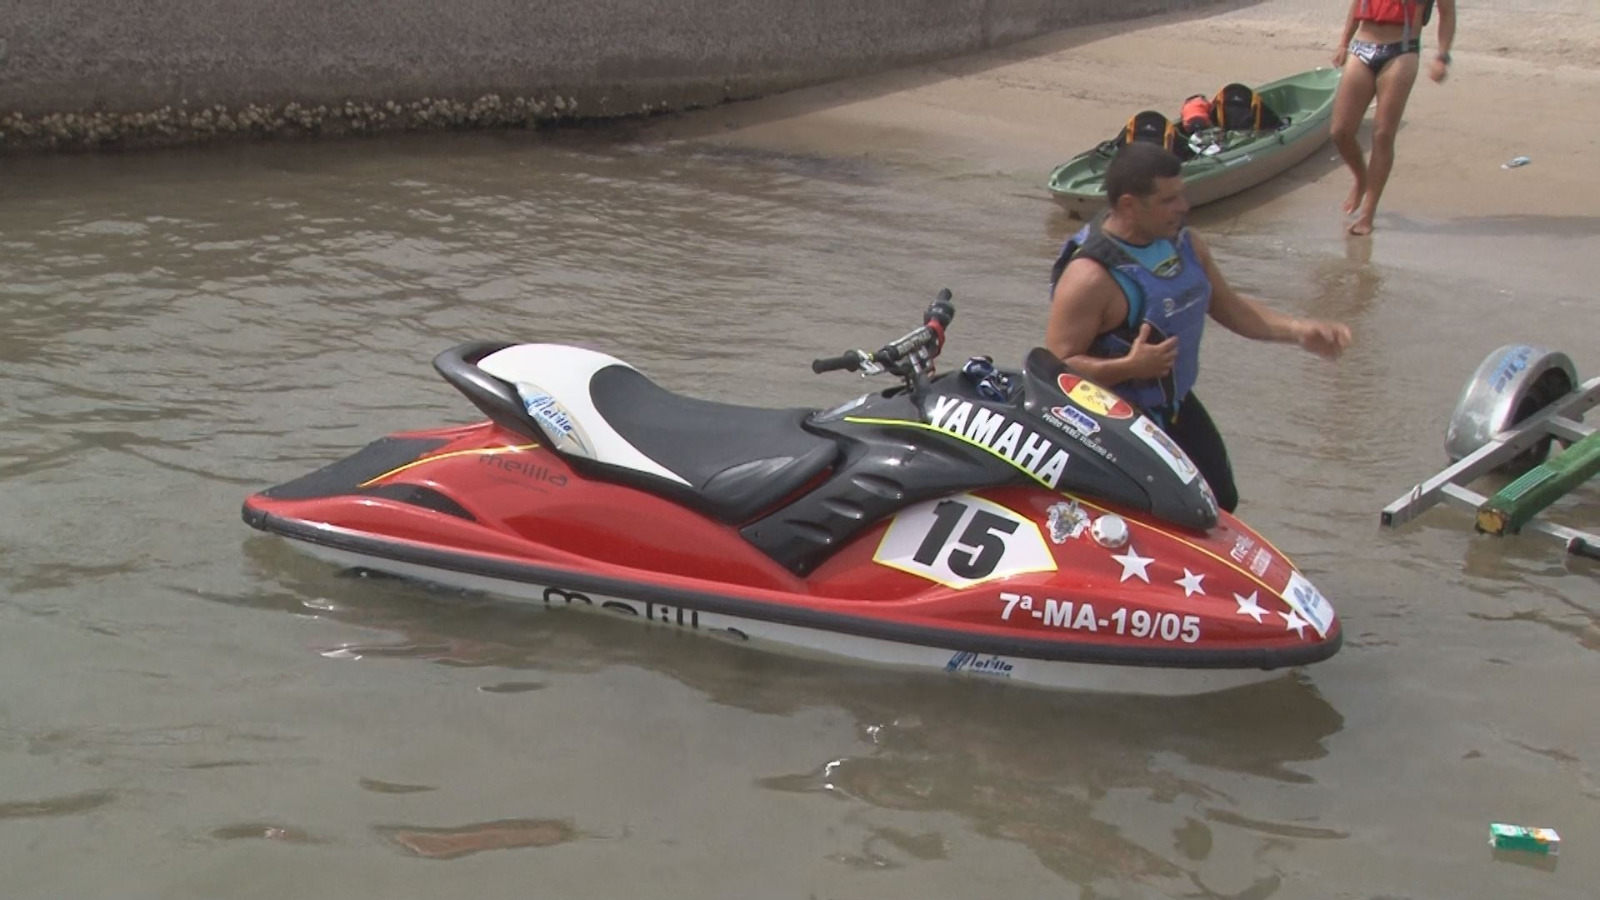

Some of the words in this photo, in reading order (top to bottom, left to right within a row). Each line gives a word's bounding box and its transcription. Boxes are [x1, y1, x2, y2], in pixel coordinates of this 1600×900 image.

[479, 454, 568, 486] melilla
[928, 396, 1070, 489] YAMAHA
[913, 500, 1020, 579] 15
